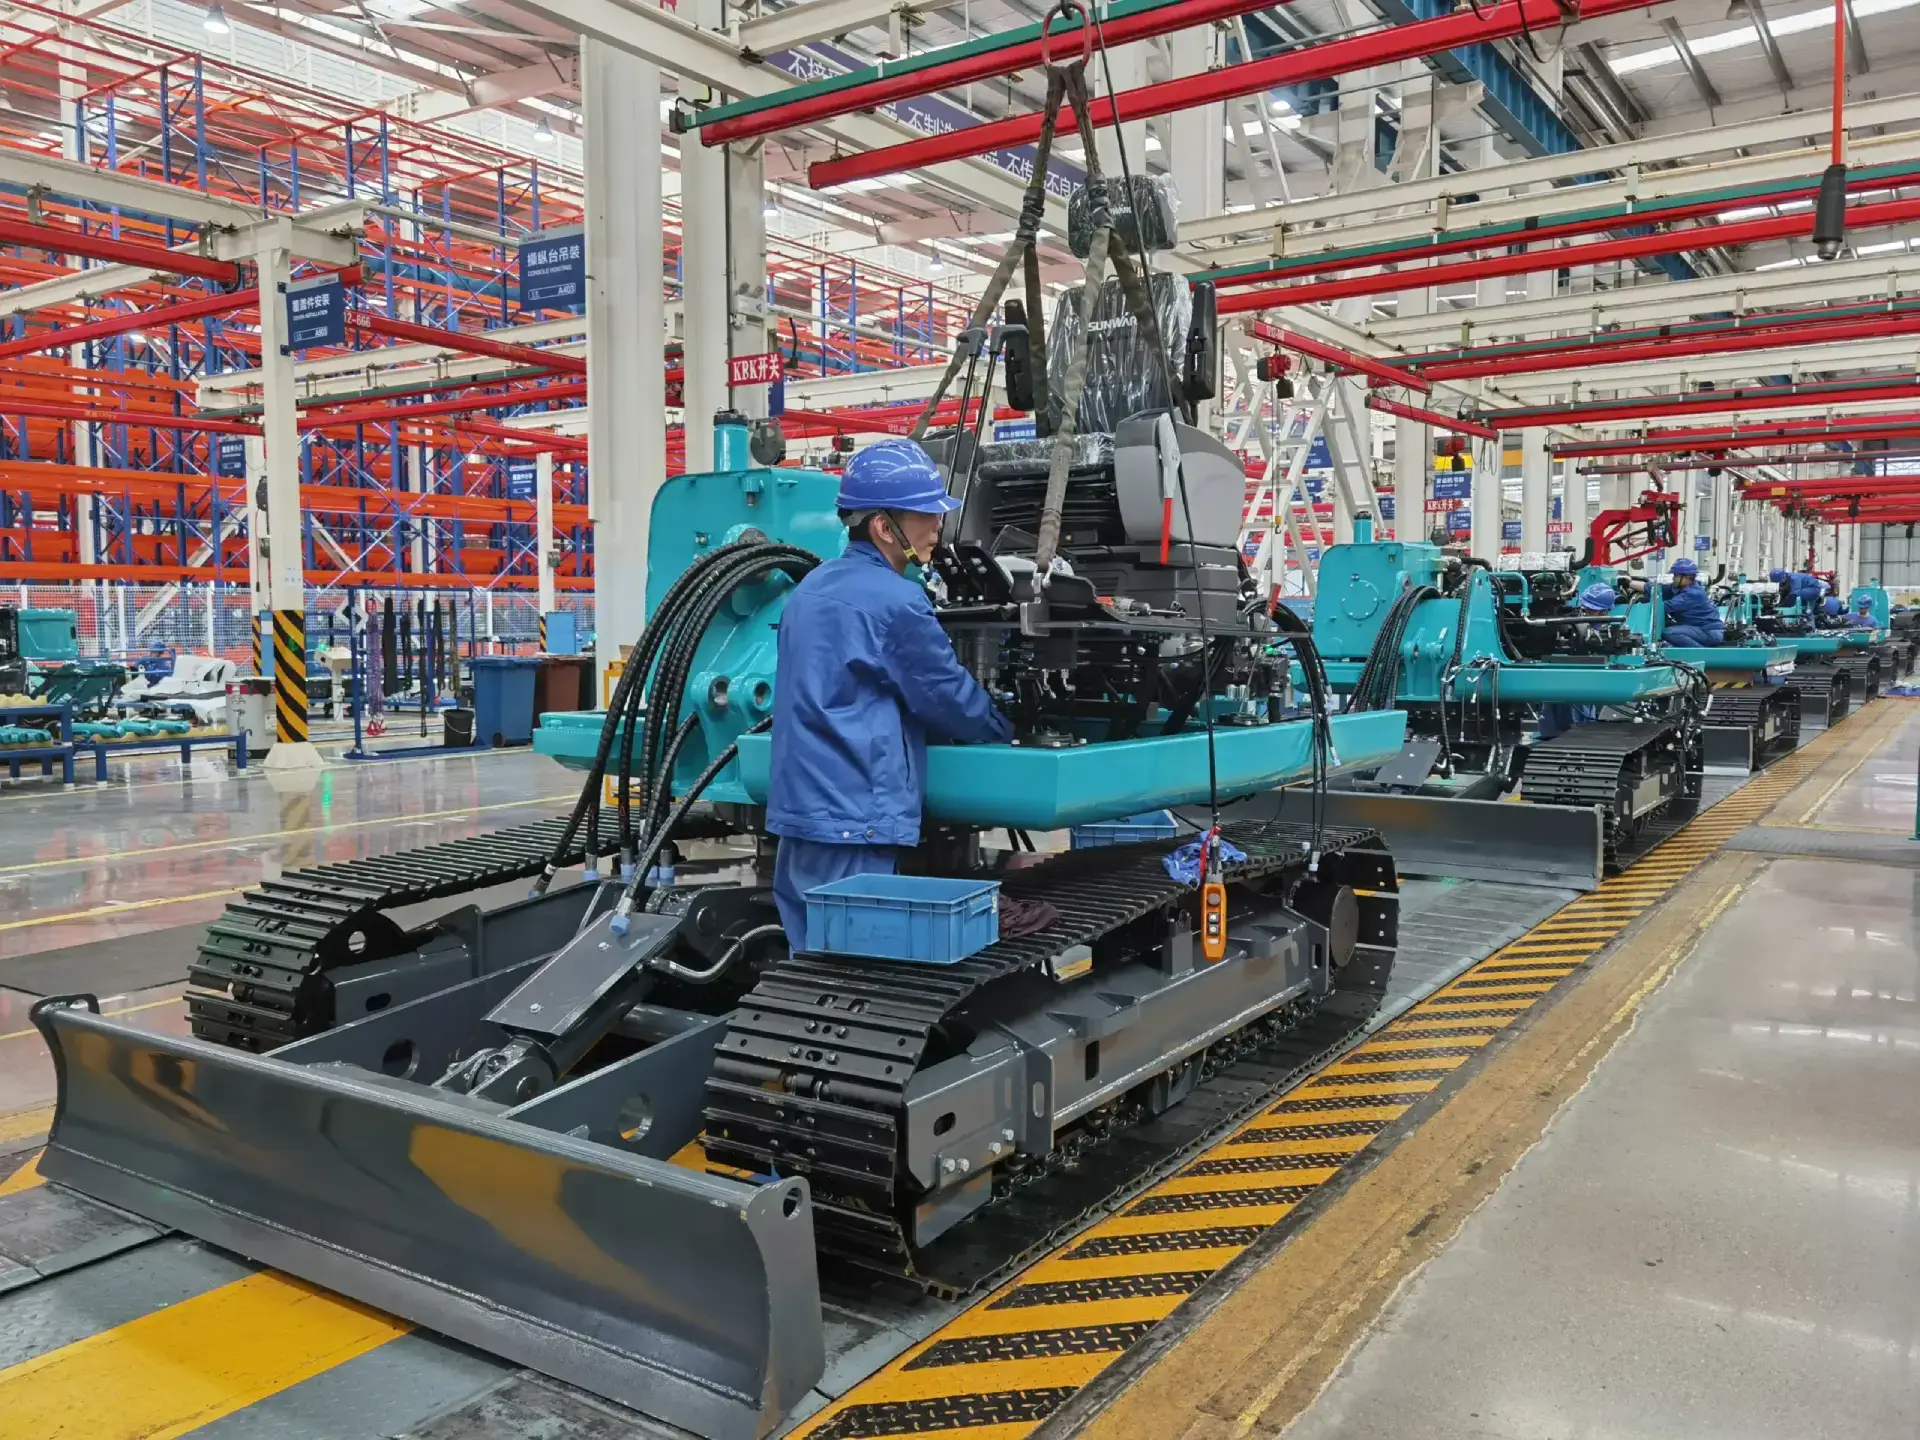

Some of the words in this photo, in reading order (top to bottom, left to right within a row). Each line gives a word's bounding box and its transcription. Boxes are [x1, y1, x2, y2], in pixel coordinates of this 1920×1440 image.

[527, 244, 580, 267] 操纵台吊装
[558, 284, 575, 296] A403
[1088, 314, 1138, 331] SUNWAR
[733, 354, 780, 381] KBK开关
